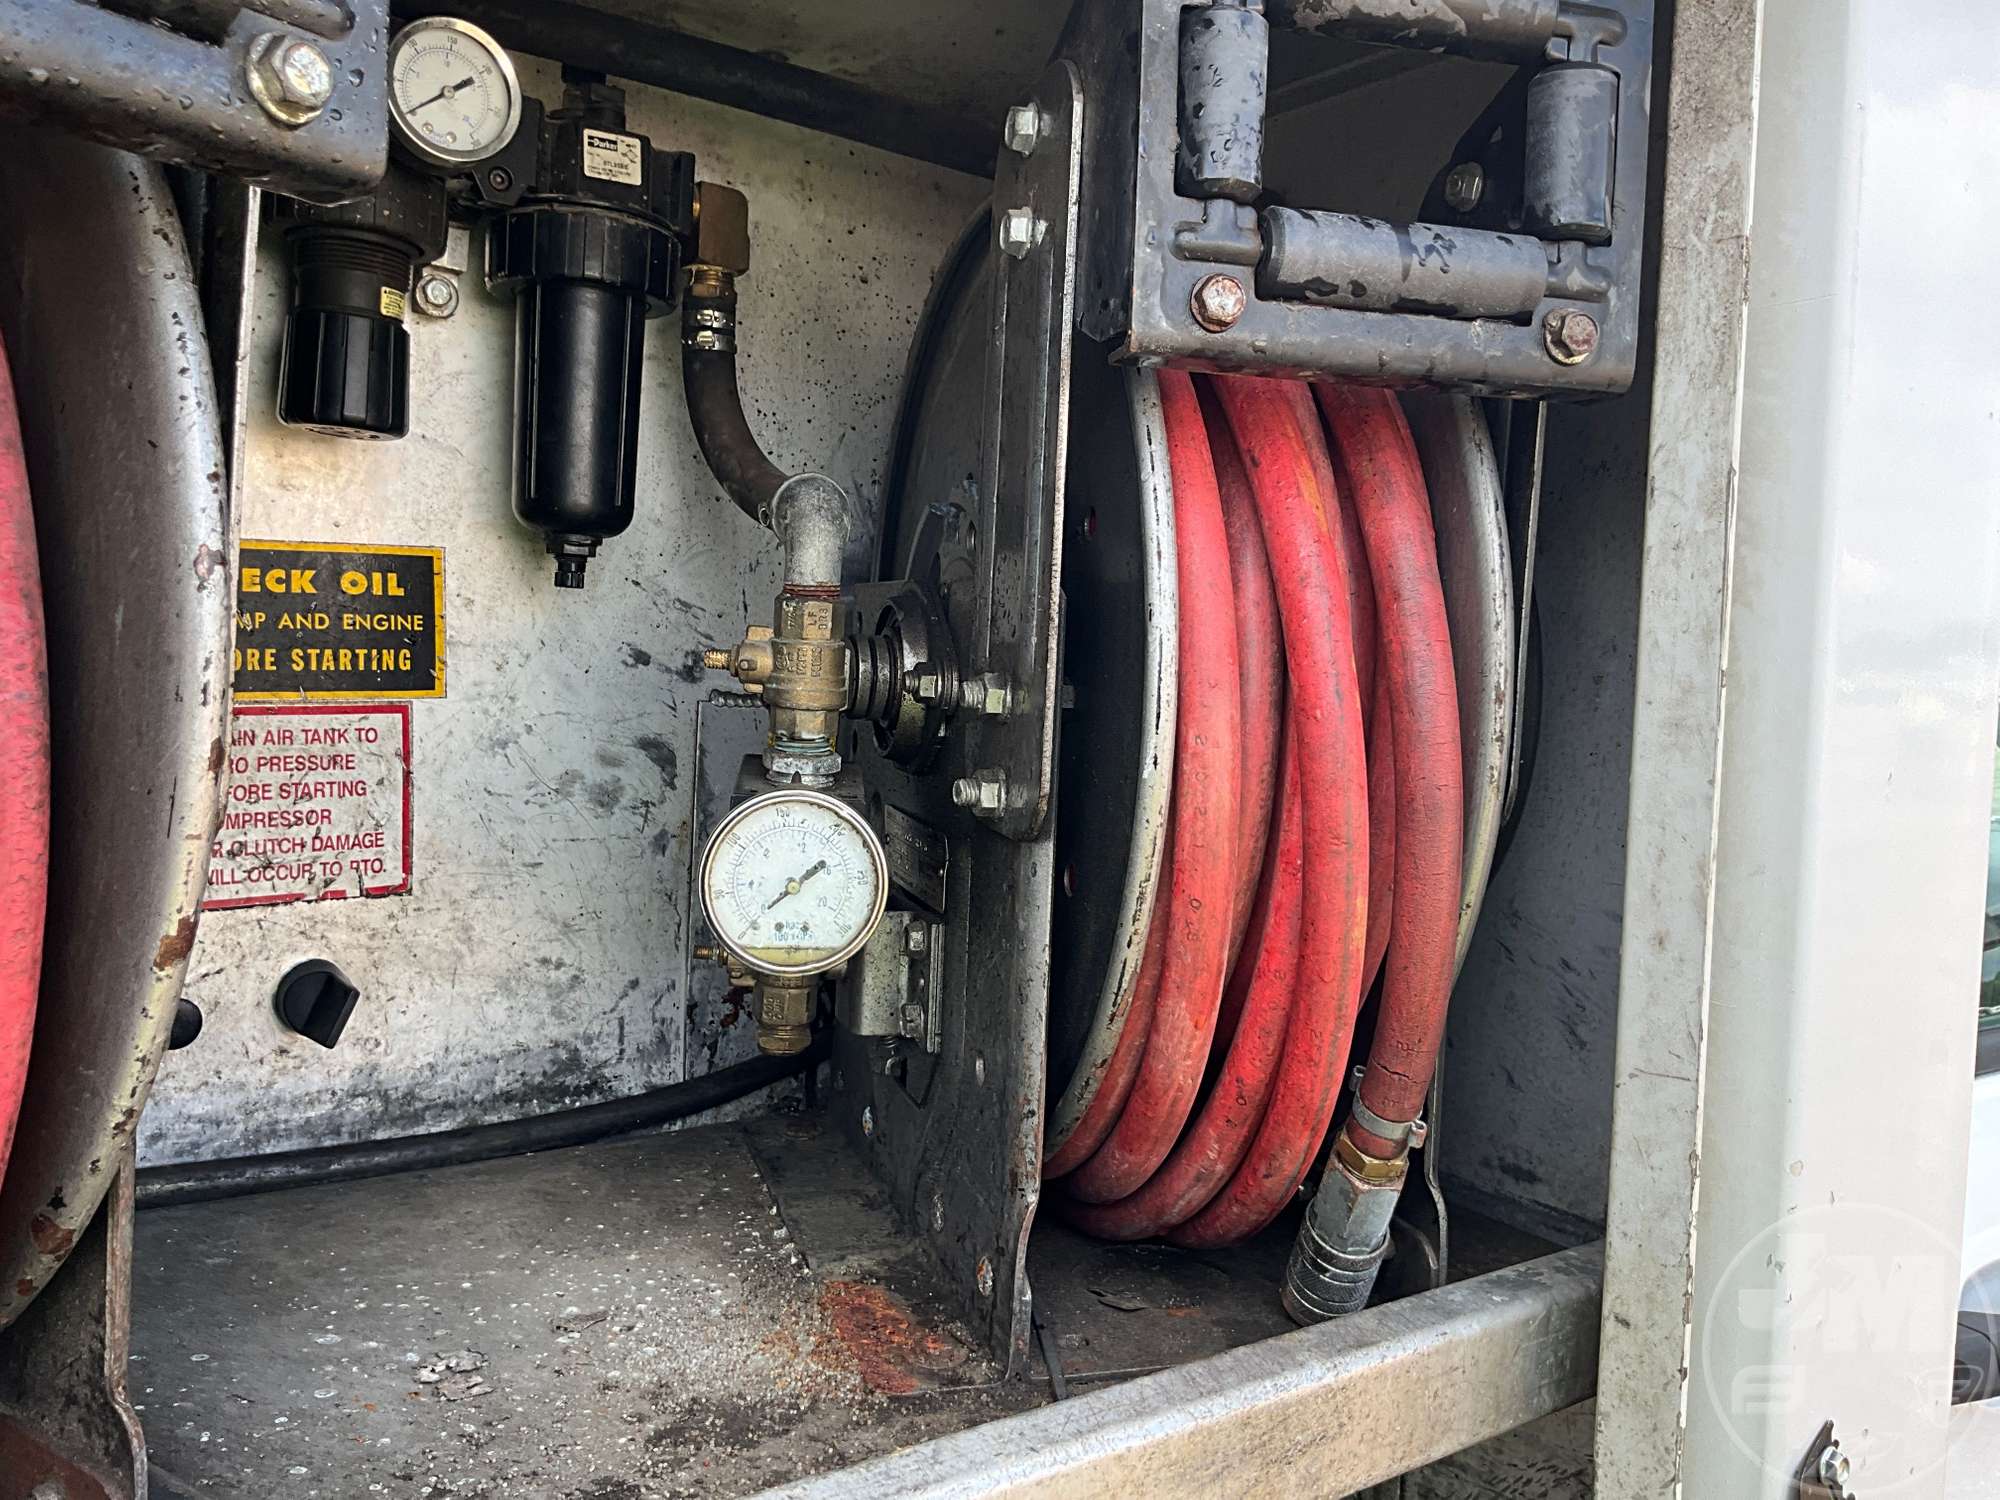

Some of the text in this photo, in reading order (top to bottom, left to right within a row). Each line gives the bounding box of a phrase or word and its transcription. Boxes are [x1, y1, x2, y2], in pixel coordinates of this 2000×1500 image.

[340, 571, 405, 596] OIL
[278, 612, 330, 630] AND
[343, 613, 423, 631] ENGINE
[291, 648, 411, 671] STARTING
[263, 729, 294, 745] AIR
[301, 728, 349, 745] TANK
[354, 727, 378, 743] TO
[257, 754, 356, 772] PRESSURE
[279, 780, 367, 799] STARTING
[231, 837, 305, 857] CLUTCH
[312, 832, 384, 852] DAMAGE
[247, 862, 313, 883] OCCUR
[319, 860, 343, 877] TO
